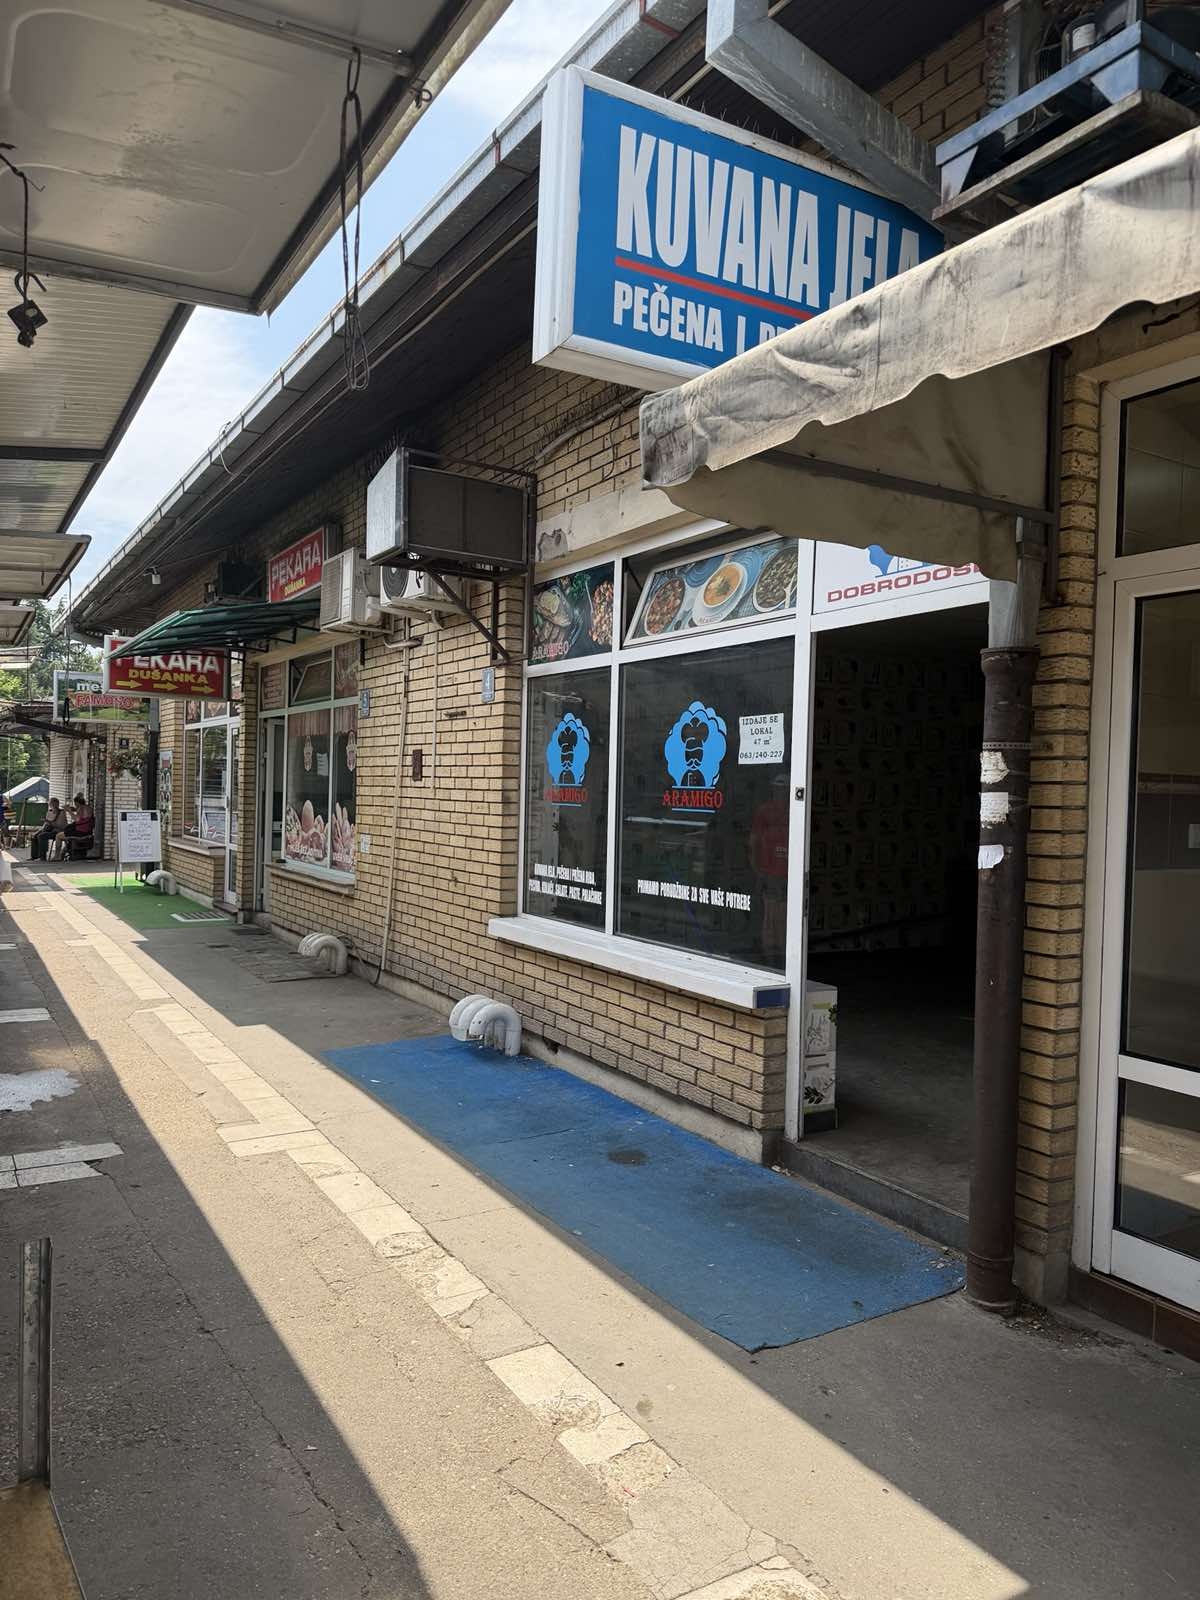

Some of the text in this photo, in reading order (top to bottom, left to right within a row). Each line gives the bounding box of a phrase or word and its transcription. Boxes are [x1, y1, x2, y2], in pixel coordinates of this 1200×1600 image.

[616, 125, 820, 309] KUVANA
[613, 281, 724, 353] PEČENA
[271, 540, 321, 592] PEKARA
[128, 668, 208, 685] DUŠANKA
[741, 715, 779, 726] IZDAJE SE
[750, 727, 773, 736] LOKAL
[544, 789, 589, 803] ARAMIGO
[662, 790, 724, 808] ARAMIGO
[690, 886, 698, 902] ZA
[699, 887, 710, 904] SVE
[710, 887, 725, 907] VAŠE
[726, 891, 751, 912] POTREBE
